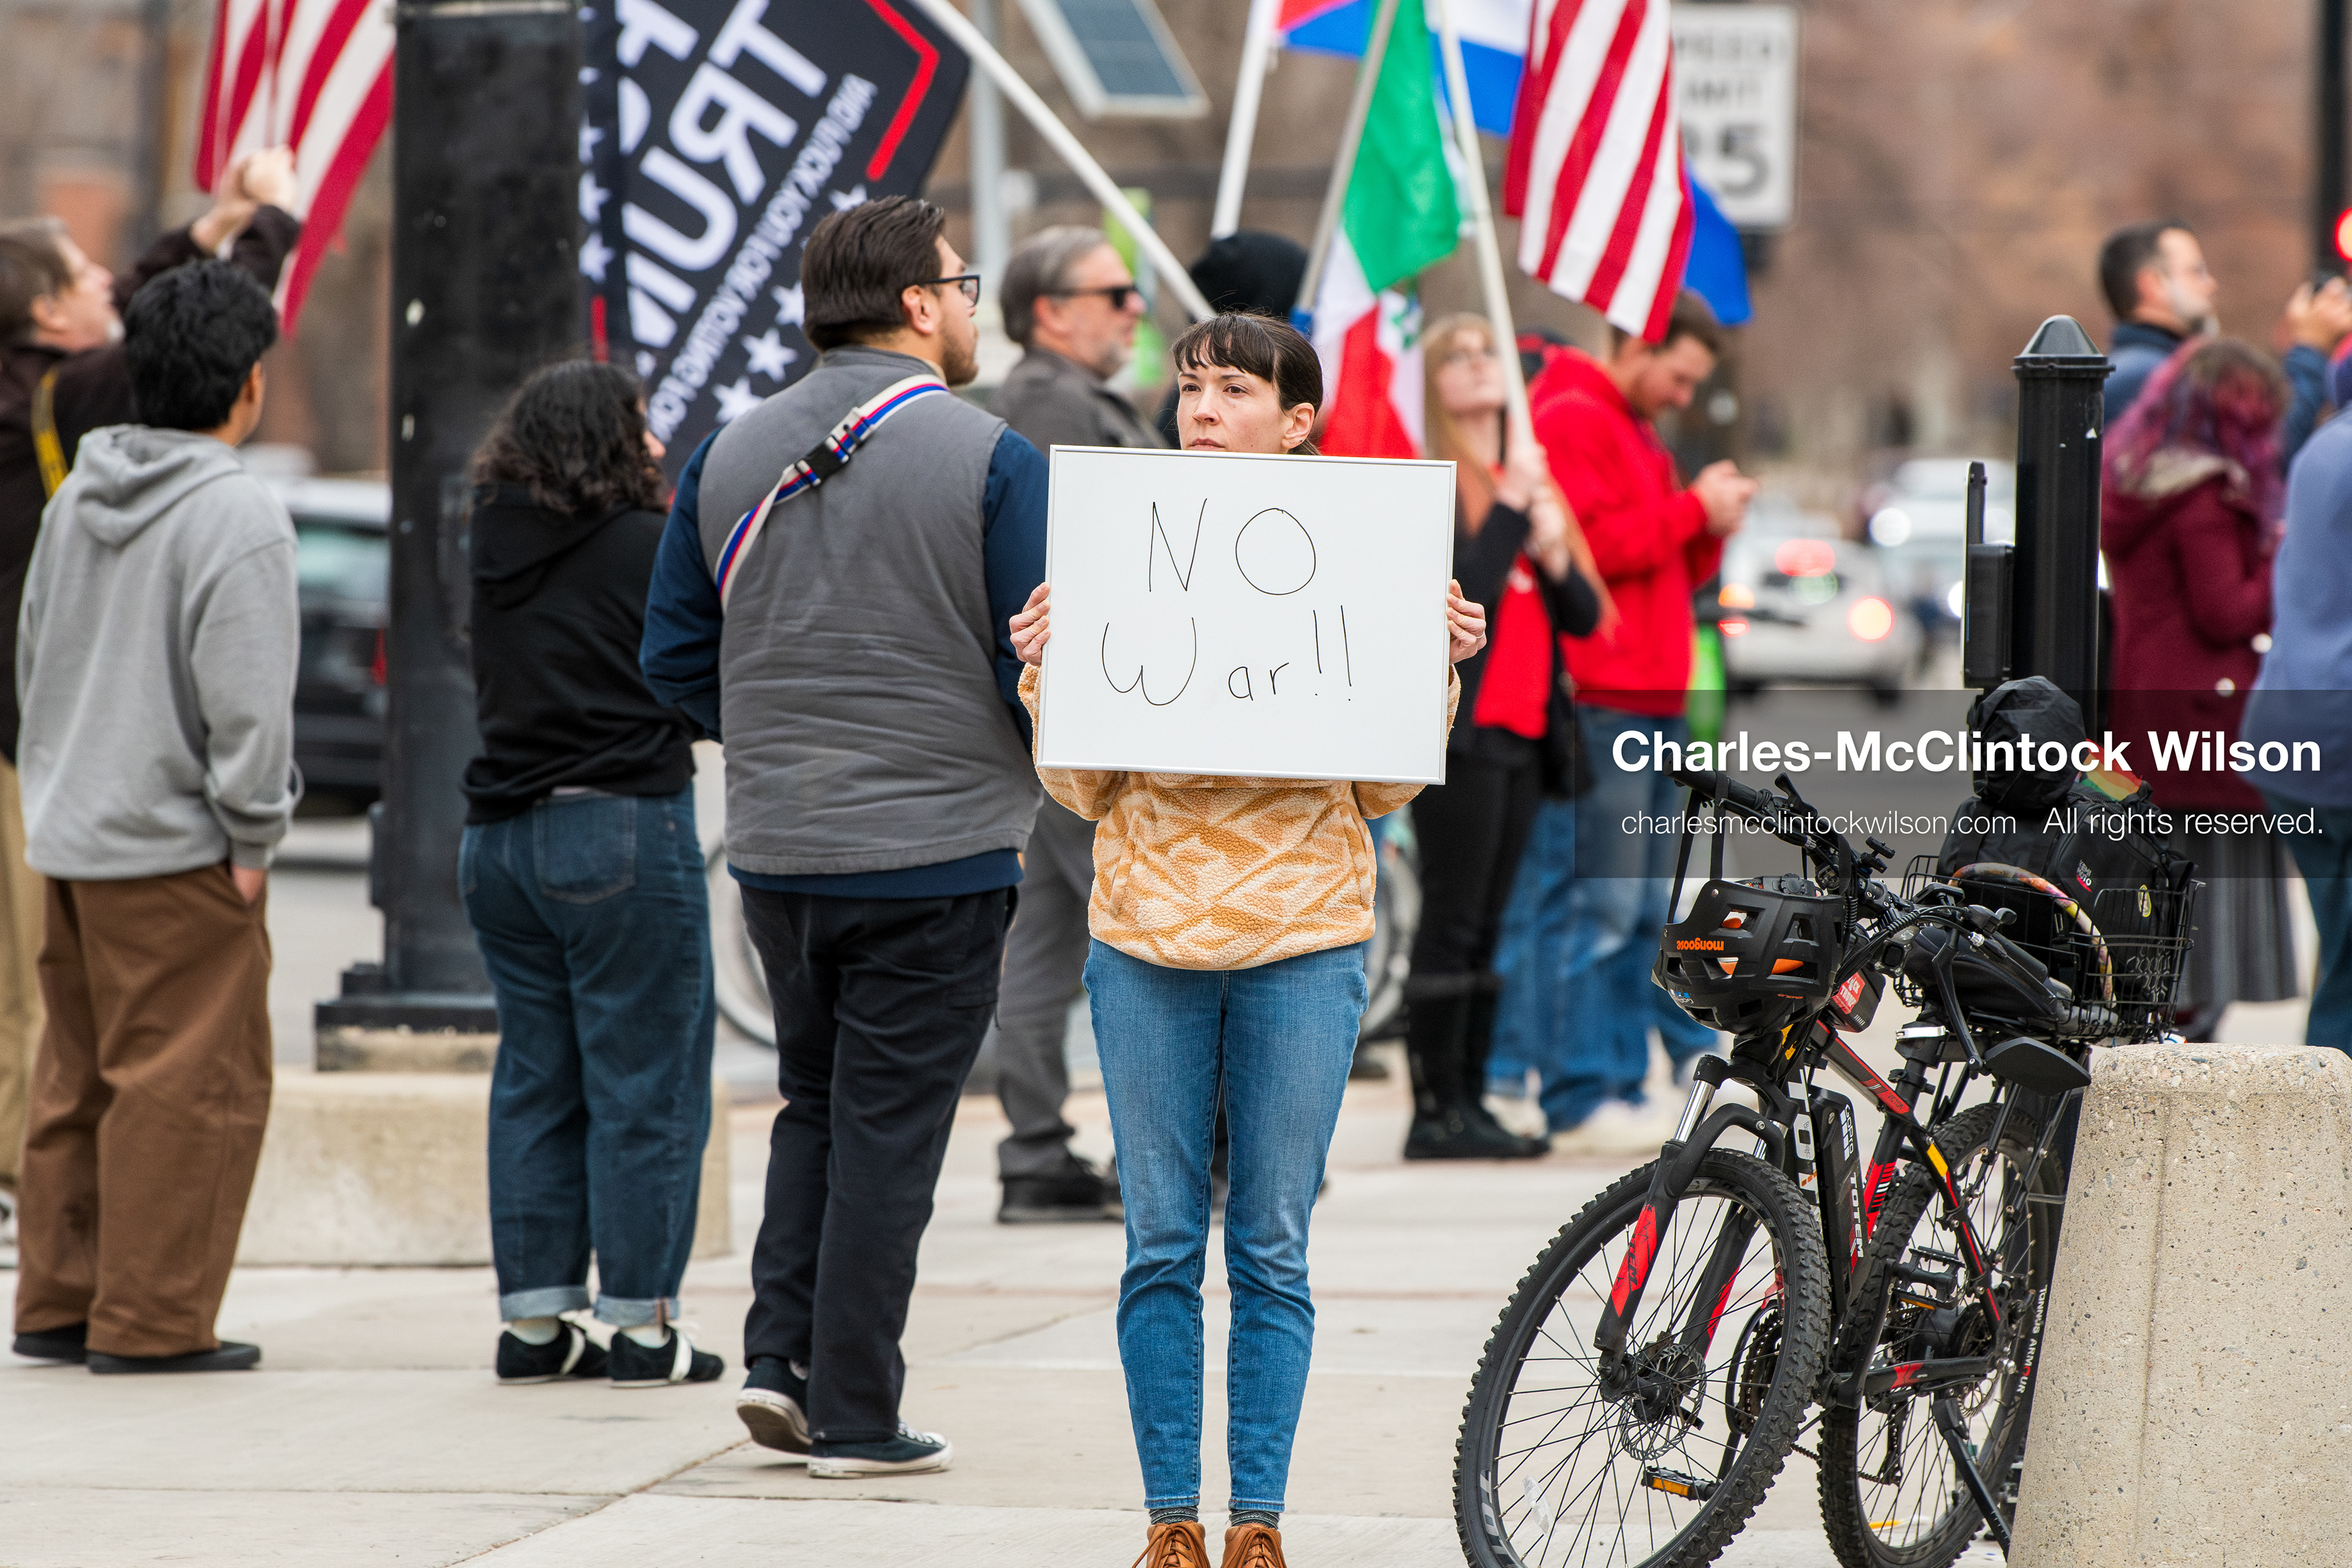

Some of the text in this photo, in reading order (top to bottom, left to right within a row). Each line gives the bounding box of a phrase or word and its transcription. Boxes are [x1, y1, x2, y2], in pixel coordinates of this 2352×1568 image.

[1148, 497, 1317, 596] NO
[1102, 605, 1352, 706] War!!
[1676, 937, 1724, 951] mongoose
[1839, 984, 1856, 1008] TRUMP
[1787, 1068, 1822, 1226] TOT
[1850, 1171, 1864, 1258] TOTEM
[1628, 1230, 1638, 1287] TEM
[1890, 1362, 1924, 1390] XC
